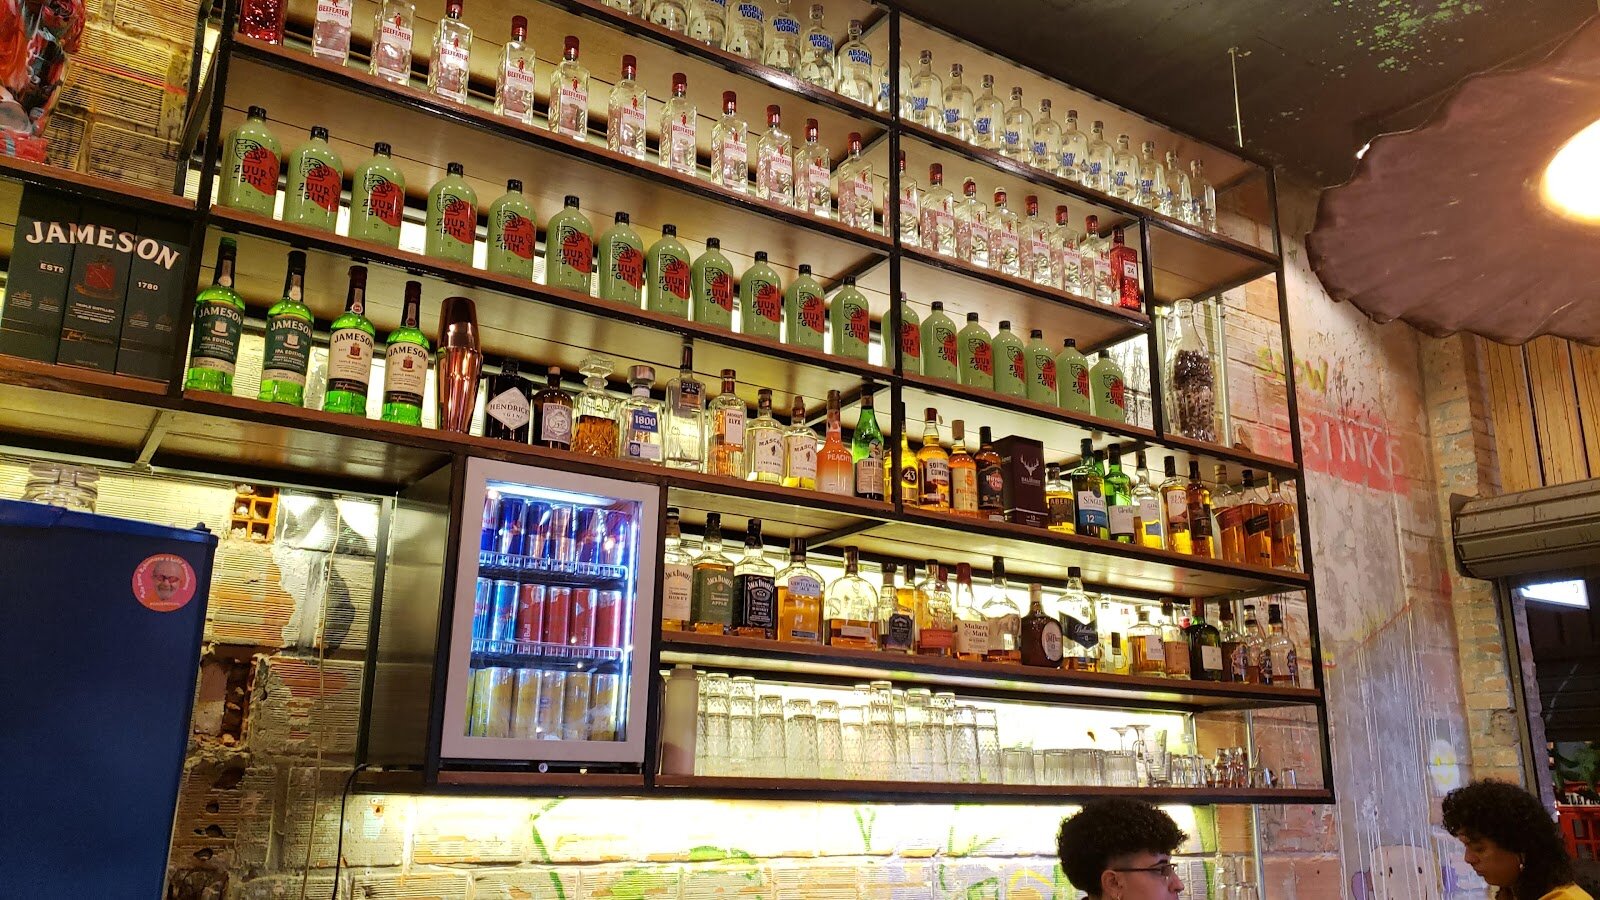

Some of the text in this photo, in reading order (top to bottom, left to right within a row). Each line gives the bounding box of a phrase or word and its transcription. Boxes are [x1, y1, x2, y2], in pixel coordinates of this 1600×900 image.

[318, 4, 349, 18] BEEFEATER
[383, 26, 411, 42] BEEFEATER
[441, 47, 468, 61] BEEFEATER
[507, 70, 534, 83] BEEFEATER
[562, 88, 587, 102] BEEFEATER
[234, 164, 267, 178] ZUUR
[298, 182, 330, 196] ZUUR
[362, 198, 394, 212] ZUUR
[436, 217, 465, 229] ZUUR
[26, 221, 181, 270] JAMESON
[495, 233, 525, 244] ZUUR
[556, 248, 584, 260] ZUUR
[611, 263, 637, 275] ZUUR
[1126, 267, 1135, 275] 24
[137, 281, 159, 291] 1780
[659, 275, 684, 287] ZUUR
[198, 306, 243, 326] JAMESON
[270, 320, 313, 338] JAMESON
[334, 333, 374, 350] JAMESON
[389, 346, 428, 362] JAMESON
[634, 415, 658, 427] 1800
[903, 470, 916, 482] 43
[1086, 515, 1096, 523] 12
